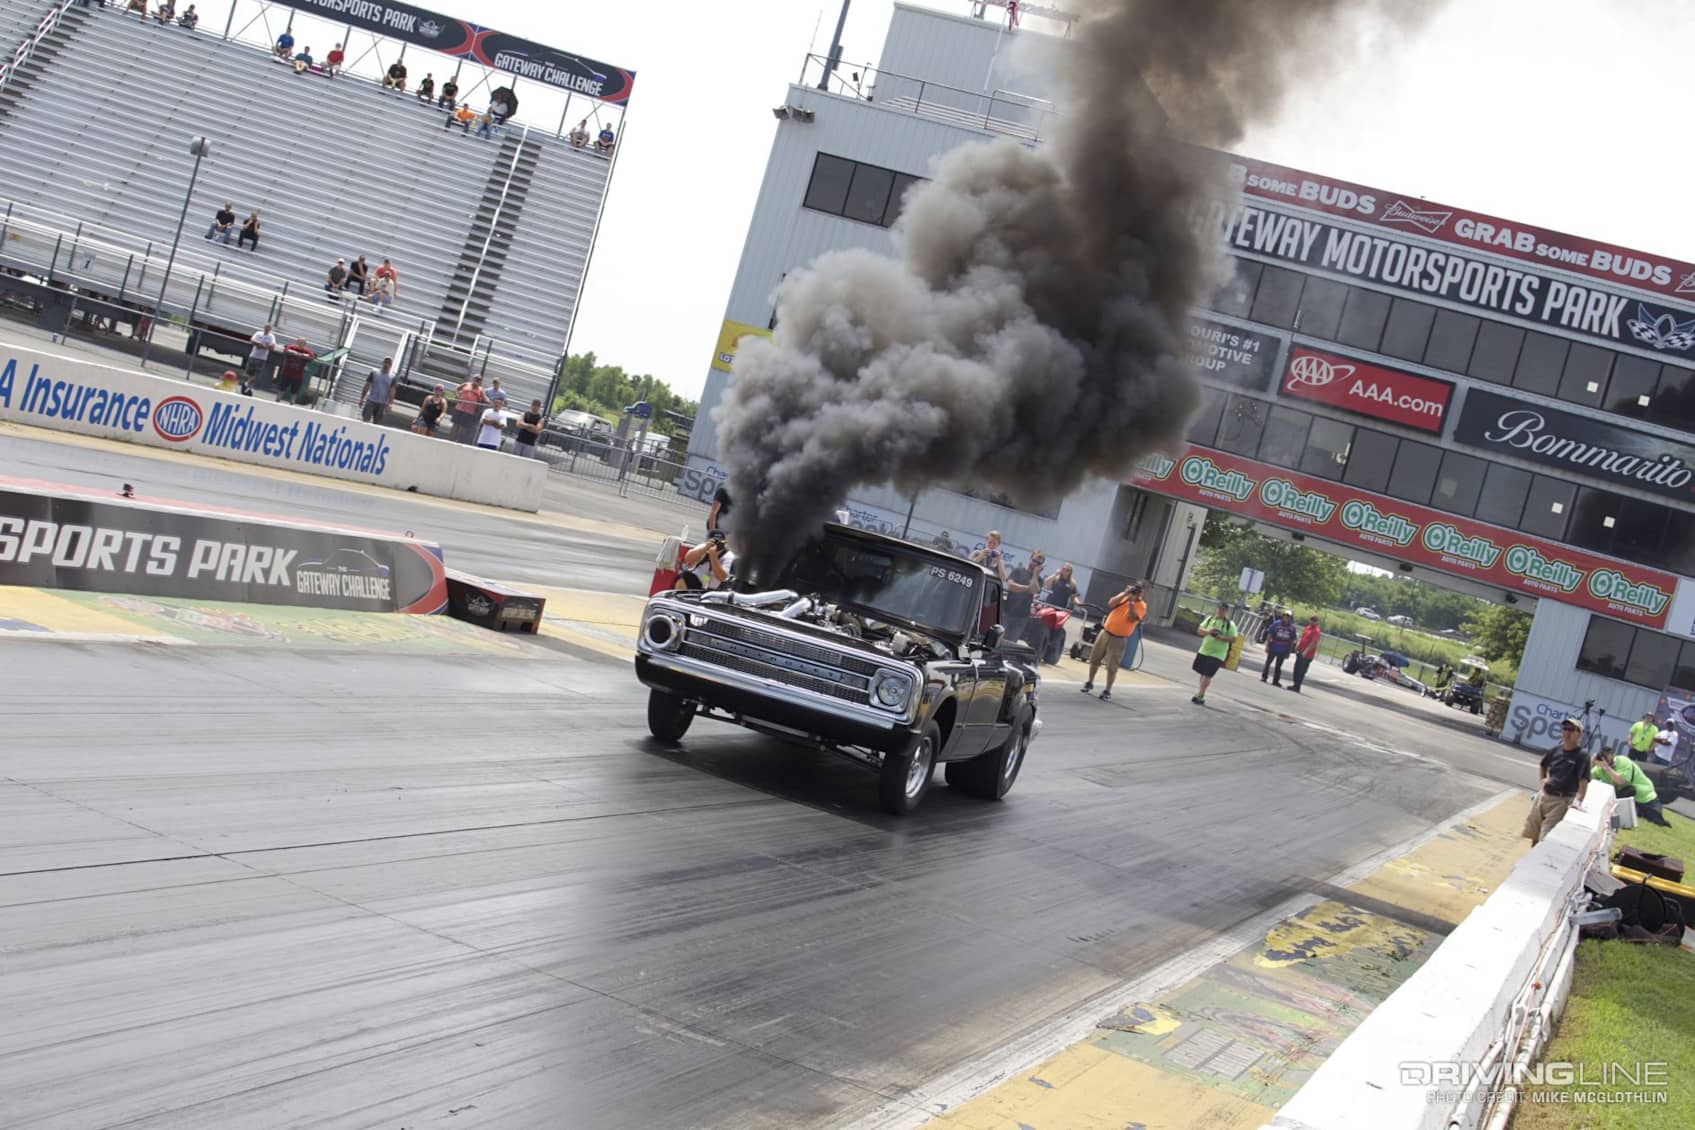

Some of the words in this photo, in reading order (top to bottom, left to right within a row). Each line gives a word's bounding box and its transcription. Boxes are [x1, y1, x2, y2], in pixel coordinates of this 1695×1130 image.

[382, 9, 416, 33] PARK
[494, 52, 545, 79] GATEWAY
[544, 68, 603, 97] CHALLENGE
[1248, 174, 1298, 197] SOME
[1299, 180, 1376, 215] BUDS
[1454, 218, 1536, 254] GRAB
[1536, 243, 1589, 267] SOME
[1590, 250, 1673, 287] BUDS
[1321, 227, 1540, 317] MOTORSPORTS
[1542, 280, 1630, 339] PARK
[1241, 339, 1261, 353] #1
[1291, 356, 1333, 386] AAA
[19, 363, 151, 432] Insurance
[157, 401, 197, 436] NHRA
[201, 402, 300, 460] Midwest
[296, 421, 390, 475] Nationals
[1349, 379, 1445, 418] AAA.com
[1484, 409, 1693, 488] Bommarito
[1181, 456, 1254, 501] O'Reilly
[1261, 479, 1337, 523] O'Reilly
[1342, 501, 1419, 546] O'Reilly
[1423, 522, 1502, 568] O'Reilly
[0, 516, 181, 576] SPORTS
[188, 540, 298, 587] PARK
[1505, 545, 1586, 592] O'Reilly
[296, 570, 341, 596] GATEWAY
[342, 574, 391, 601] CHALLENGE
[930, 566, 947, 578] PS
[947, 572, 973, 588] 6249
[1589, 569, 1672, 615] O'Reilly
